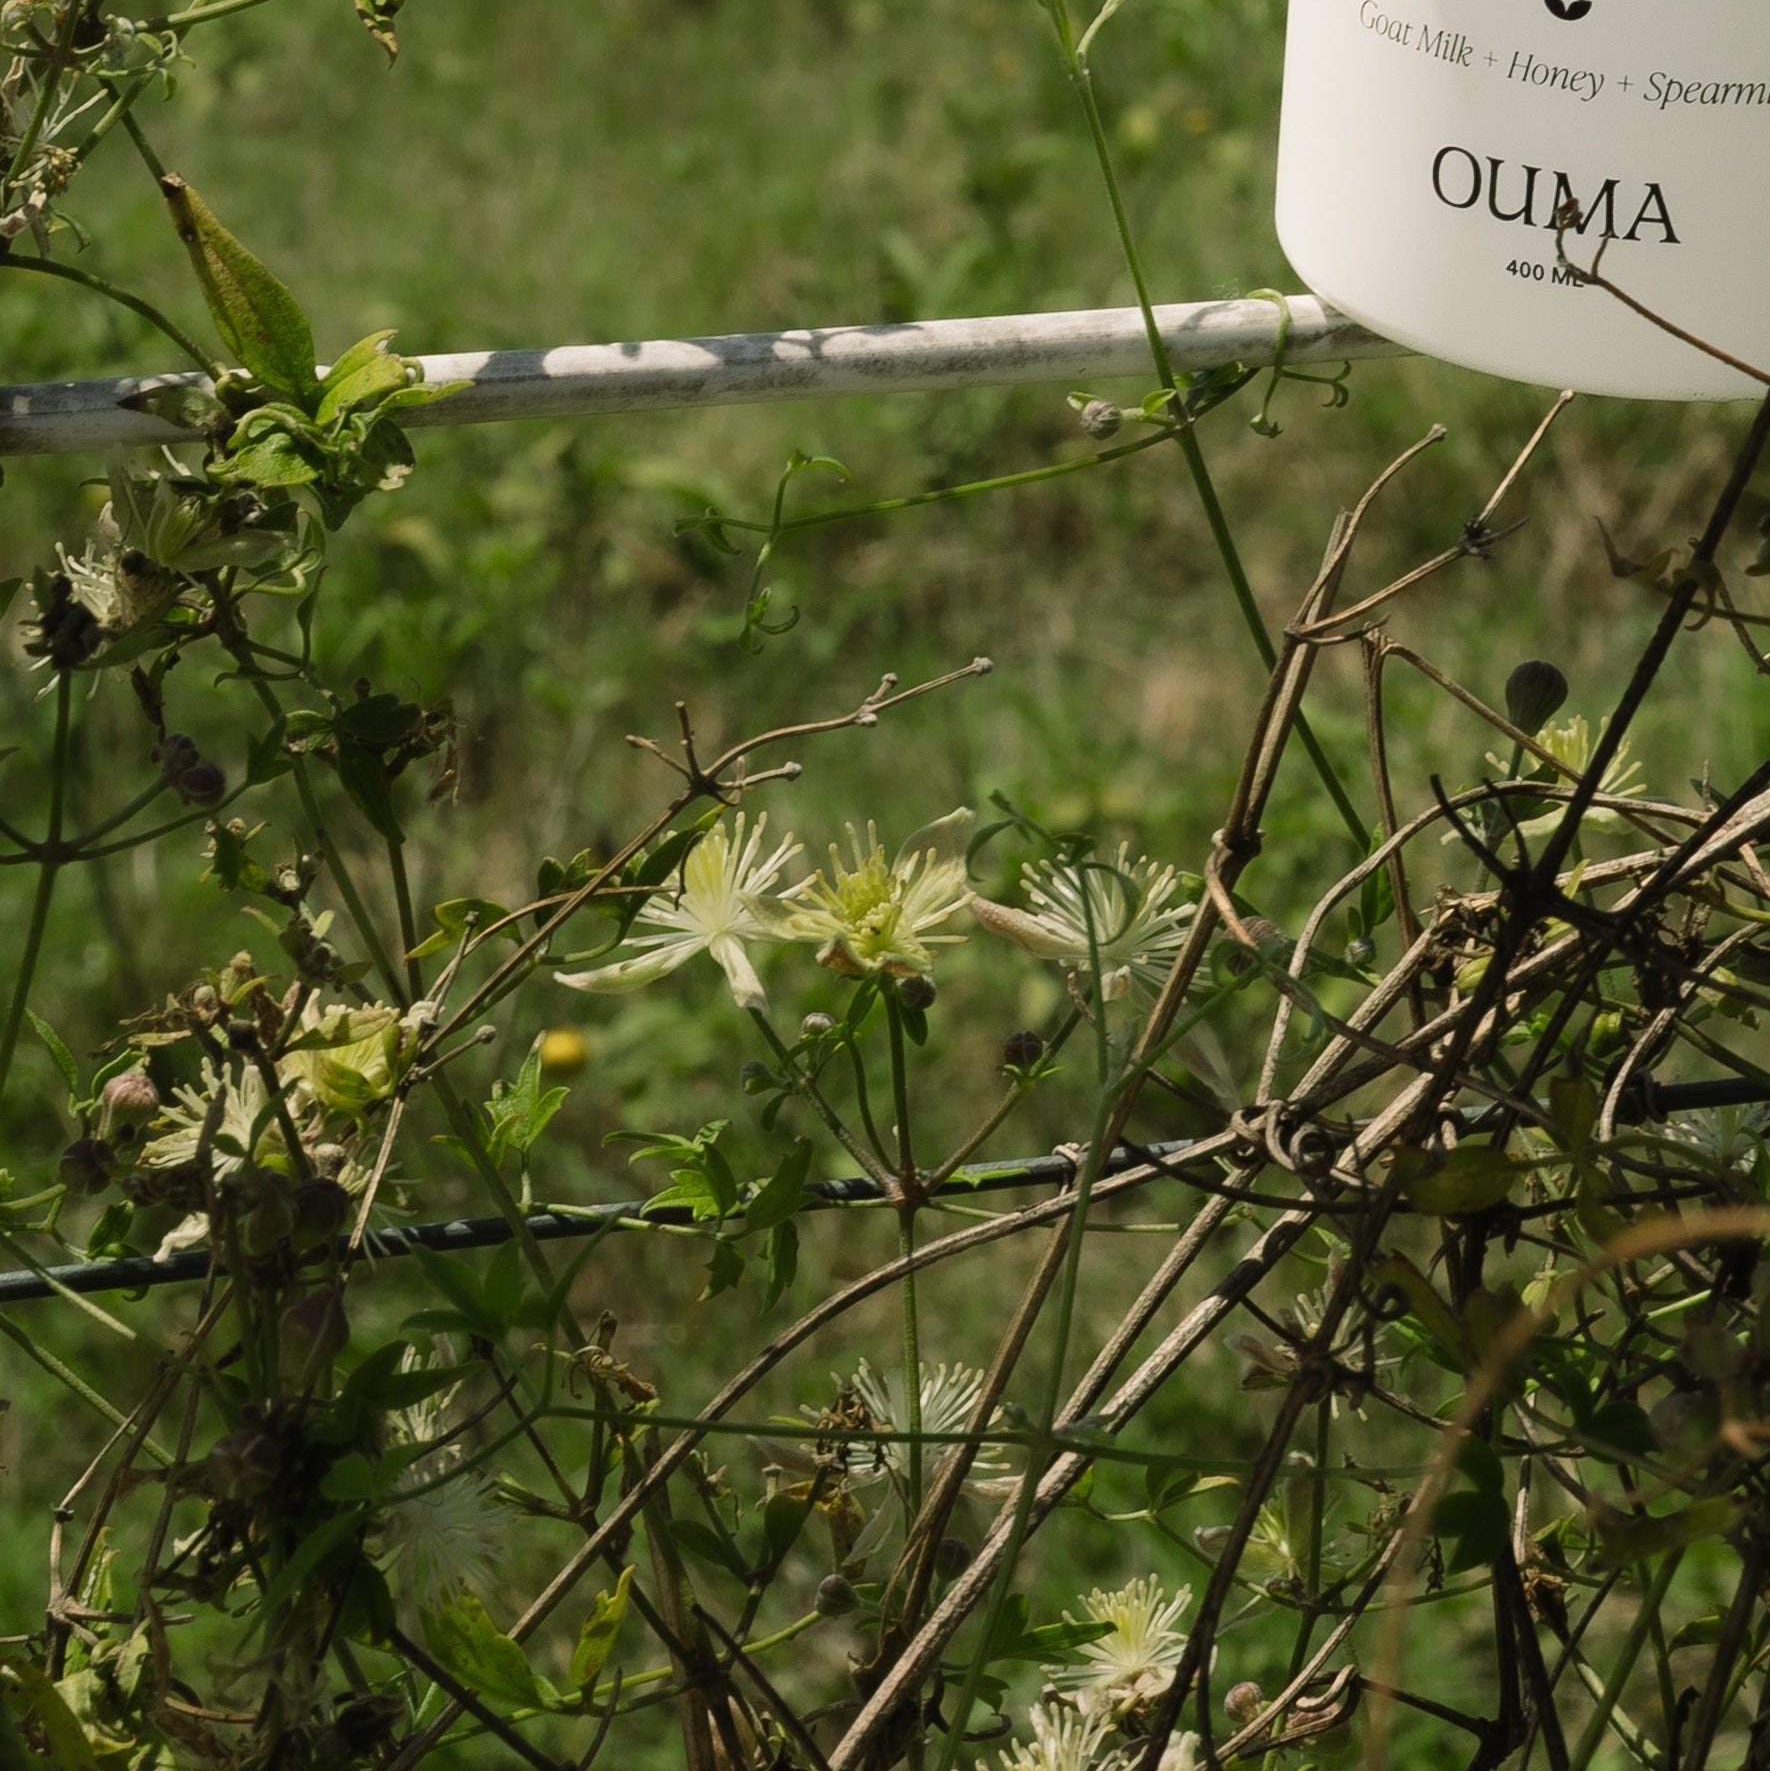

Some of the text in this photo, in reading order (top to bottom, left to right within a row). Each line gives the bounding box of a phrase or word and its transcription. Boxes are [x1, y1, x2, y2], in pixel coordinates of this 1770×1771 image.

[1415, 23, 1475, 68] Milk
[1482, 49, 1500, 69] +
[1506, 49, 1607, 103] Honey
[1616, 73, 1636, 94] +
[1430, 145, 1682, 245] OUMA
[1505, 258, 1546, 282] 400
